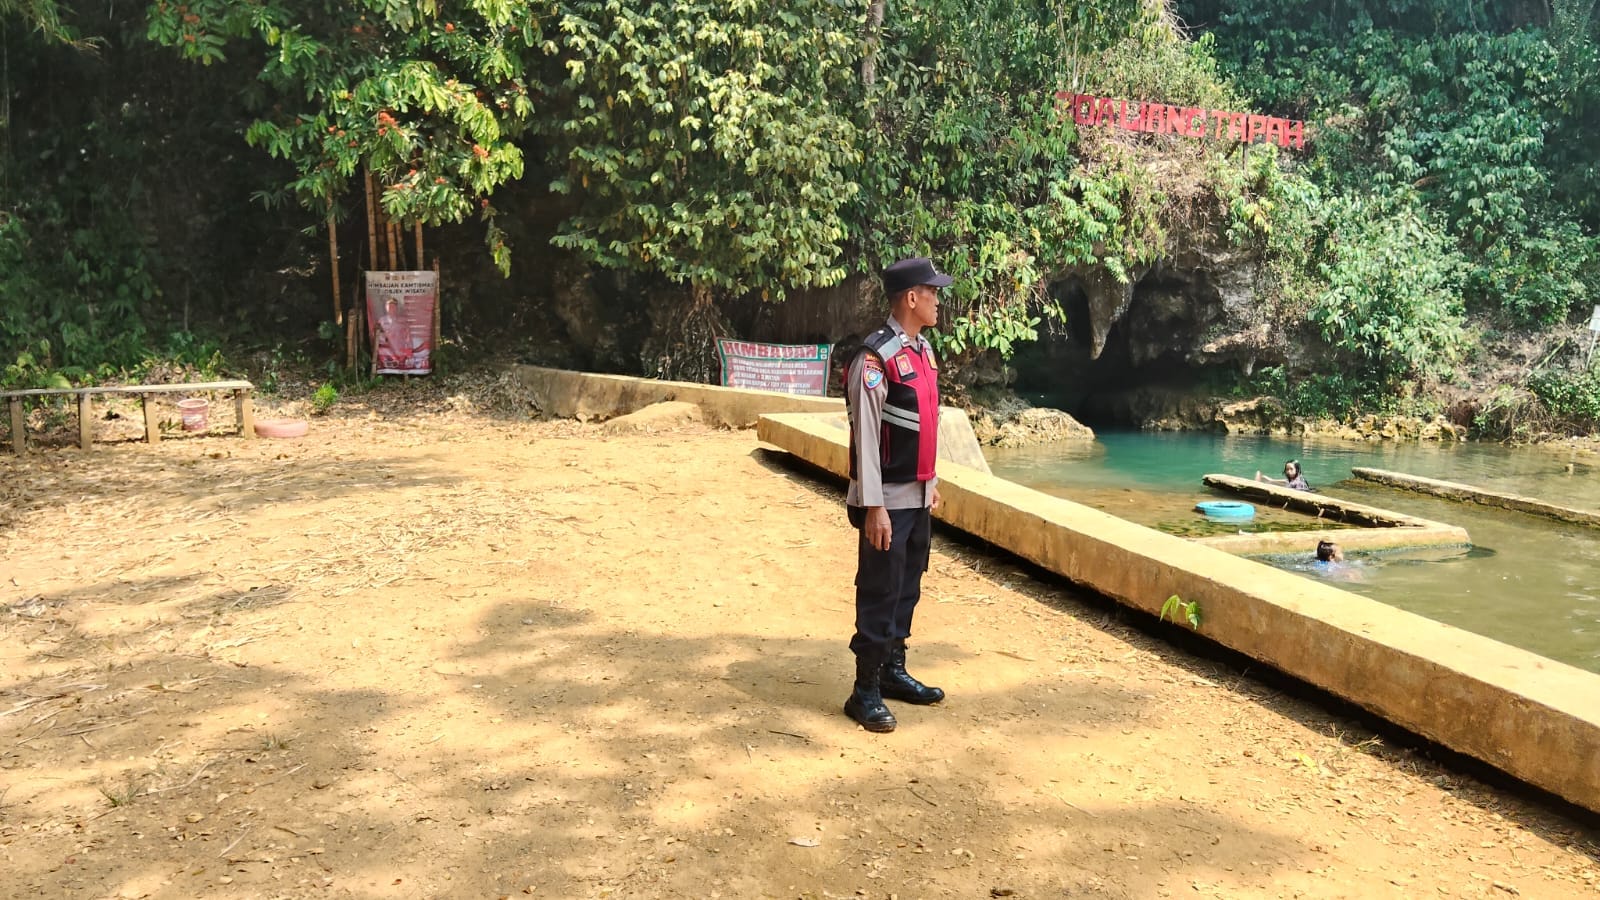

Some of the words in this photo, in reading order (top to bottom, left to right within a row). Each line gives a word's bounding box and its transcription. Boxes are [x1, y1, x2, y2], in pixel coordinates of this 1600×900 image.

[1120, 99, 1206, 138] LIANG
[1212, 109, 1304, 149] TAPAH
[722, 341, 817, 359] HIMBAUAN
